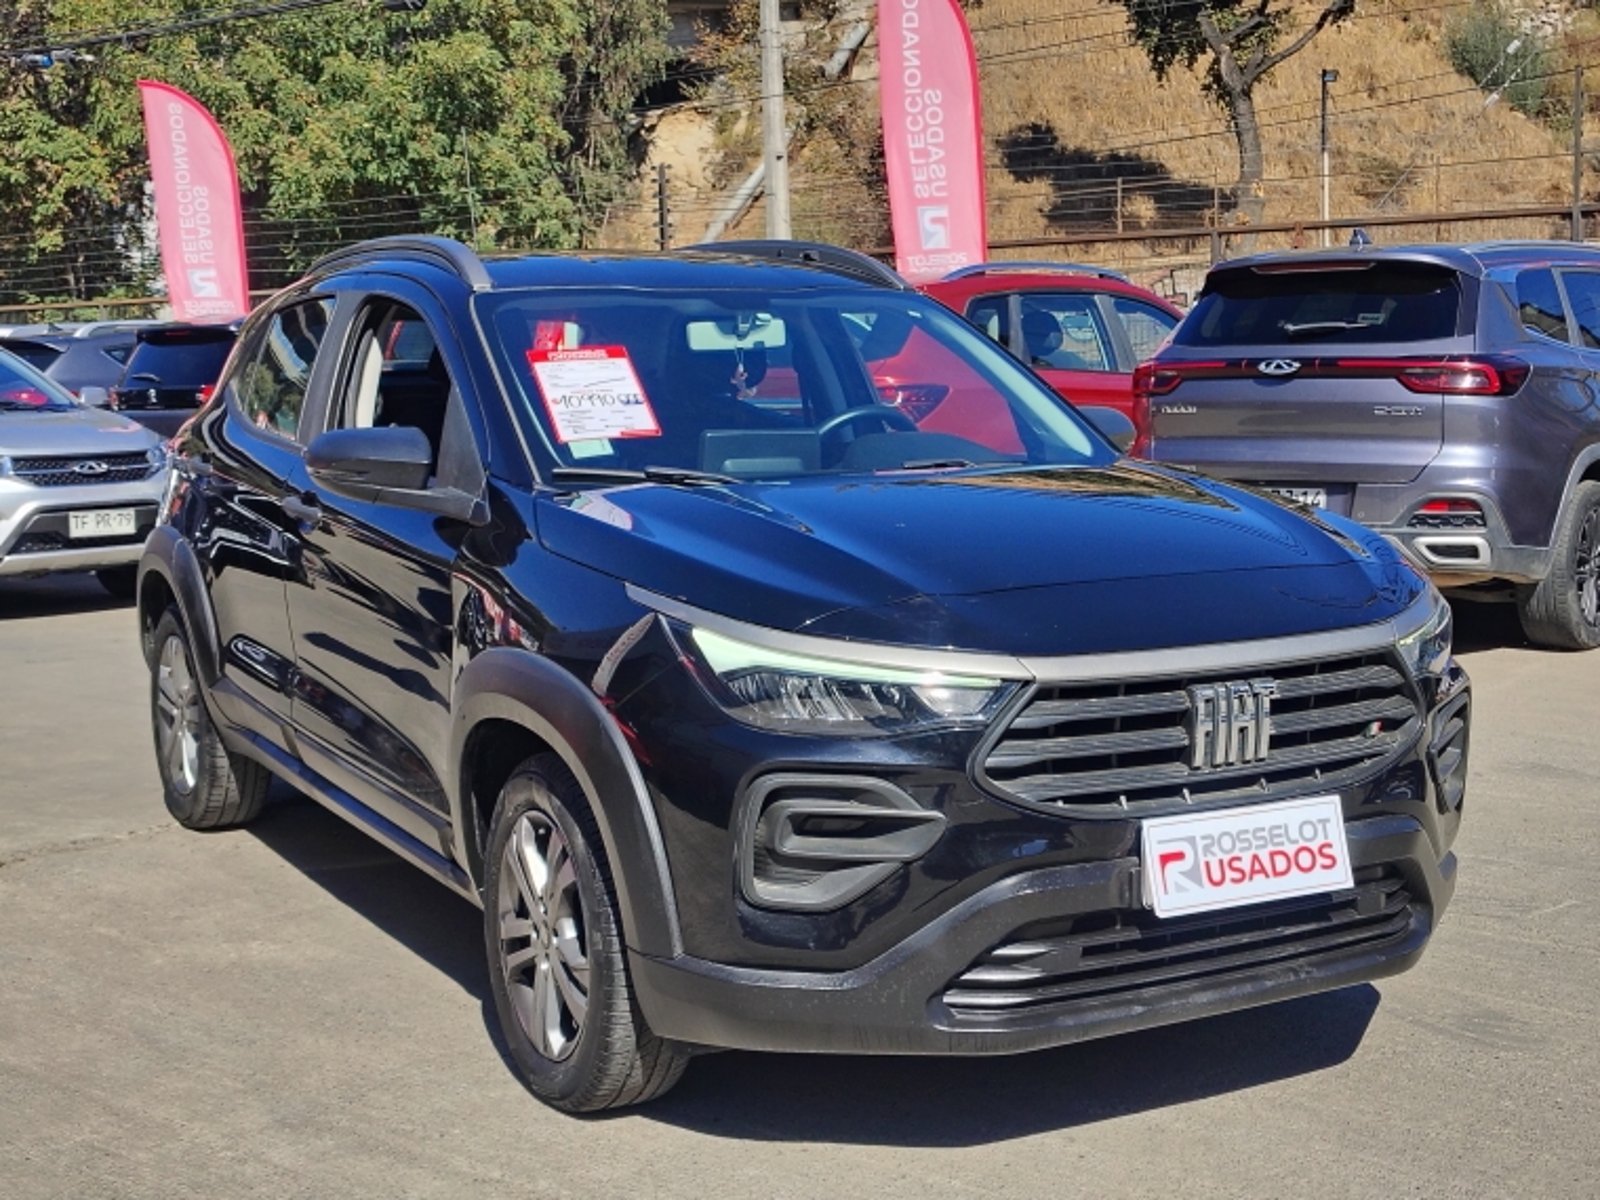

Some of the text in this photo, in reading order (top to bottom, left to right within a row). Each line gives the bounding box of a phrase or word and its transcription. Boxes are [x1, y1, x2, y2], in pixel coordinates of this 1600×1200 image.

[72, 515, 89, 529] TF
[1187, 677, 1276, 769] FIAT
[1201, 818, 1331, 857] ROSSELOT
[1204, 843, 1337, 887] USADOS
